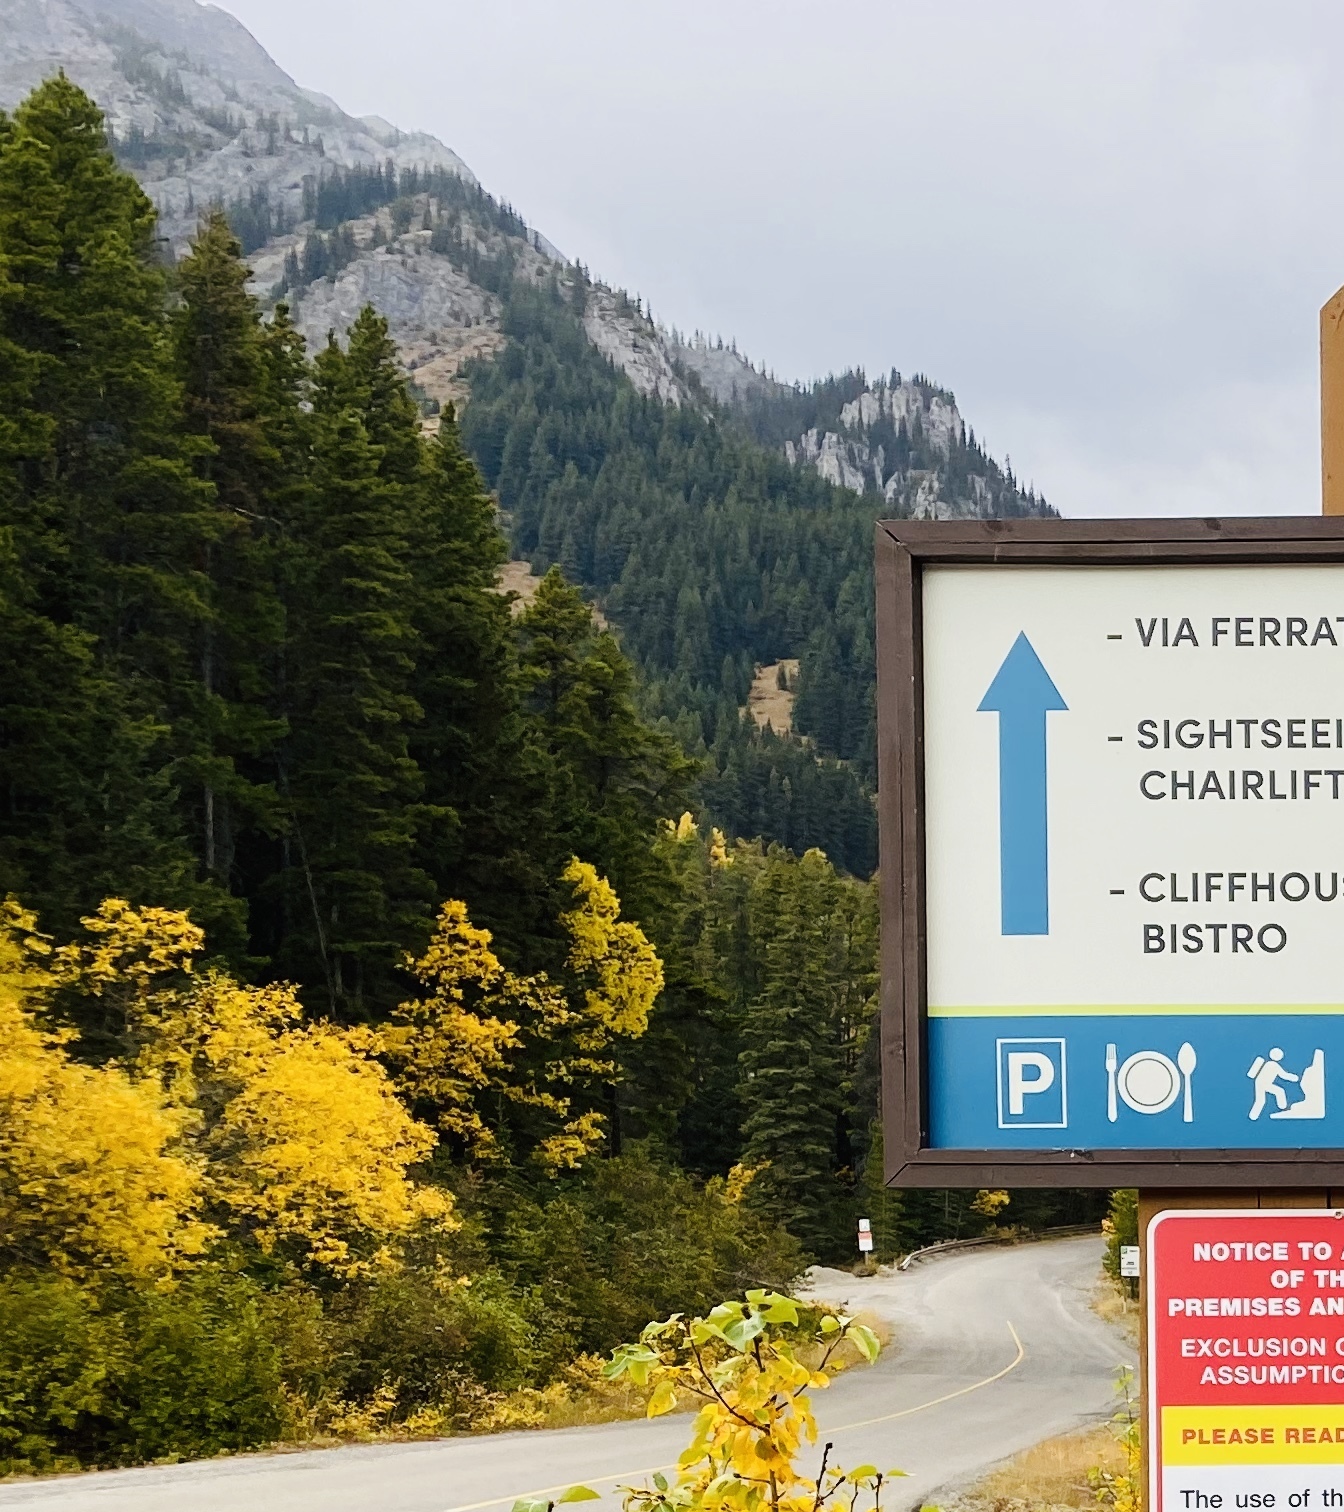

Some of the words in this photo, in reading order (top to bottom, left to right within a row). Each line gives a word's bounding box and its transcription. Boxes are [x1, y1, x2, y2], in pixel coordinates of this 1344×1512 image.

[1135, 618, 1198, 647] VIA
[1144, 924, 1286, 953] BISTRO
[1009, 1053, 1054, 1114] P
[1194, 1243, 1288, 1261] NOTICE
[1298, 1242, 1332, 1260] TO
[1271, 1270, 1304, 1288] OF
[1169, 1298, 1300, 1316] PREMISES
[1182, 1338, 1325, 1356] EXCLUSION
[1183, 1429, 1274, 1444] PLEASE
[1180, 1490, 1222, 1508] The
[1236, 1494, 1275, 1508] use
[1289, 1489, 1310, 1507] of
